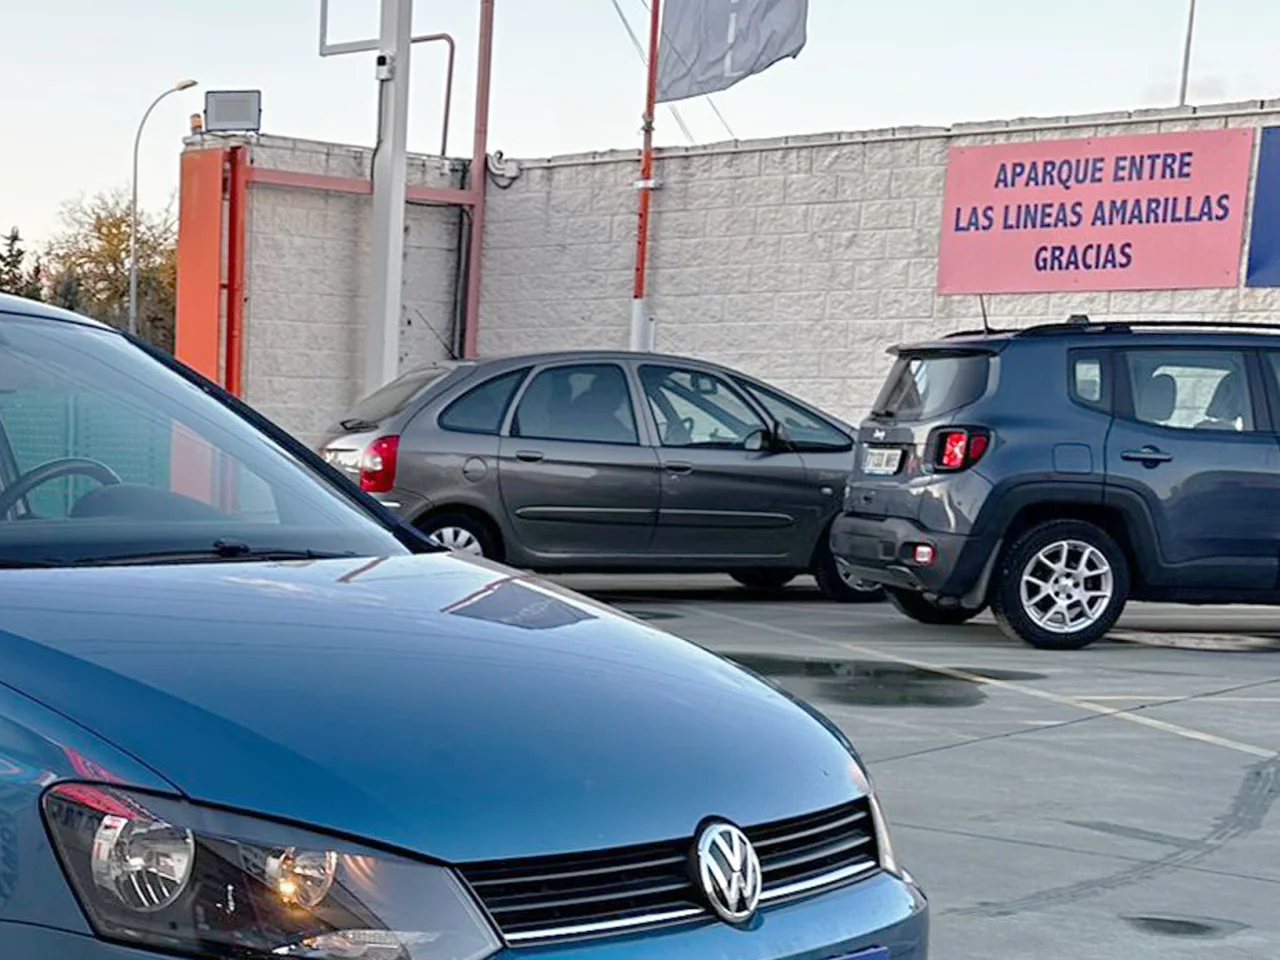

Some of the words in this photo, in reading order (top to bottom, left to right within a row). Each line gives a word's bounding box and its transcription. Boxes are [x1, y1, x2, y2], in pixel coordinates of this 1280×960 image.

[994, 157, 1105, 192] APARQUE
[1112, 151, 1194, 183] ENTRE
[954, 206, 994, 232] LAS
[1002, 201, 1083, 231] LINEAS
[1091, 194, 1231, 227] AMARILLAS
[1034, 242, 1133, 272] GRACIAS
